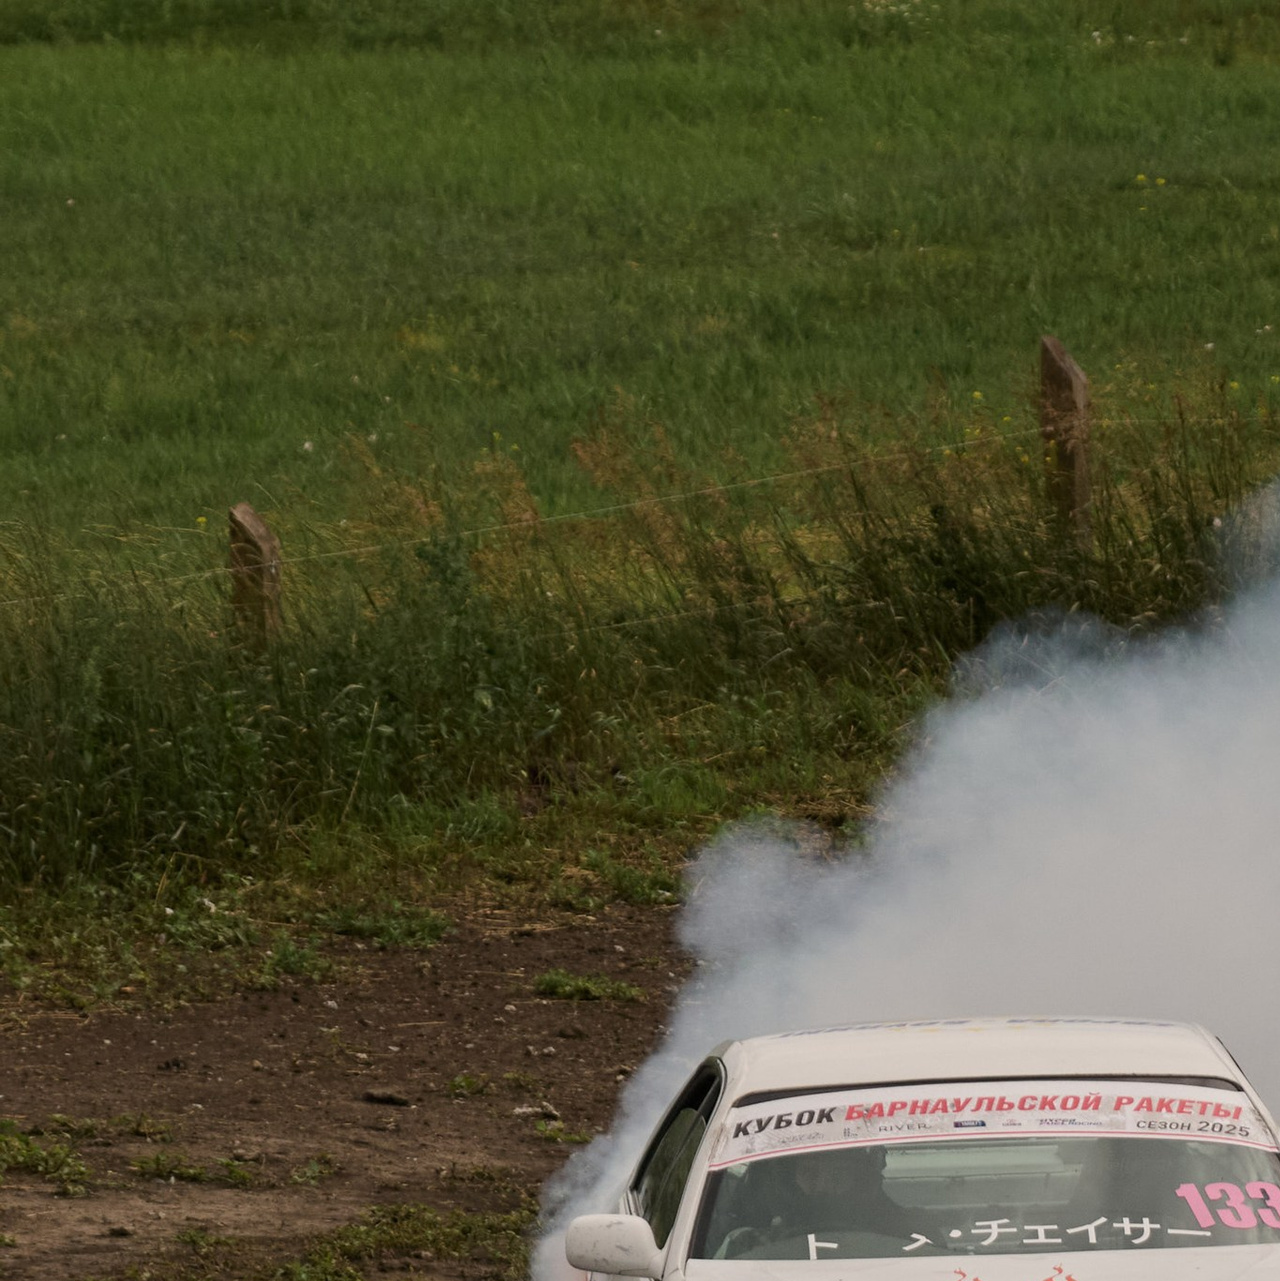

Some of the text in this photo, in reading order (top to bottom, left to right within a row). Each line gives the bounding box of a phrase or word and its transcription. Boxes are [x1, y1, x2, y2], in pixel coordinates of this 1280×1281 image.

[732, 1106, 837, 1139] КУБОК
[844, 1092, 1103, 1121] БАРНАУЛЬСКОЙ
[1113, 1095, 1243, 1120] РАКЕТЫ
[1136, 1120, 1250, 1137] СЕЗОН 2025
